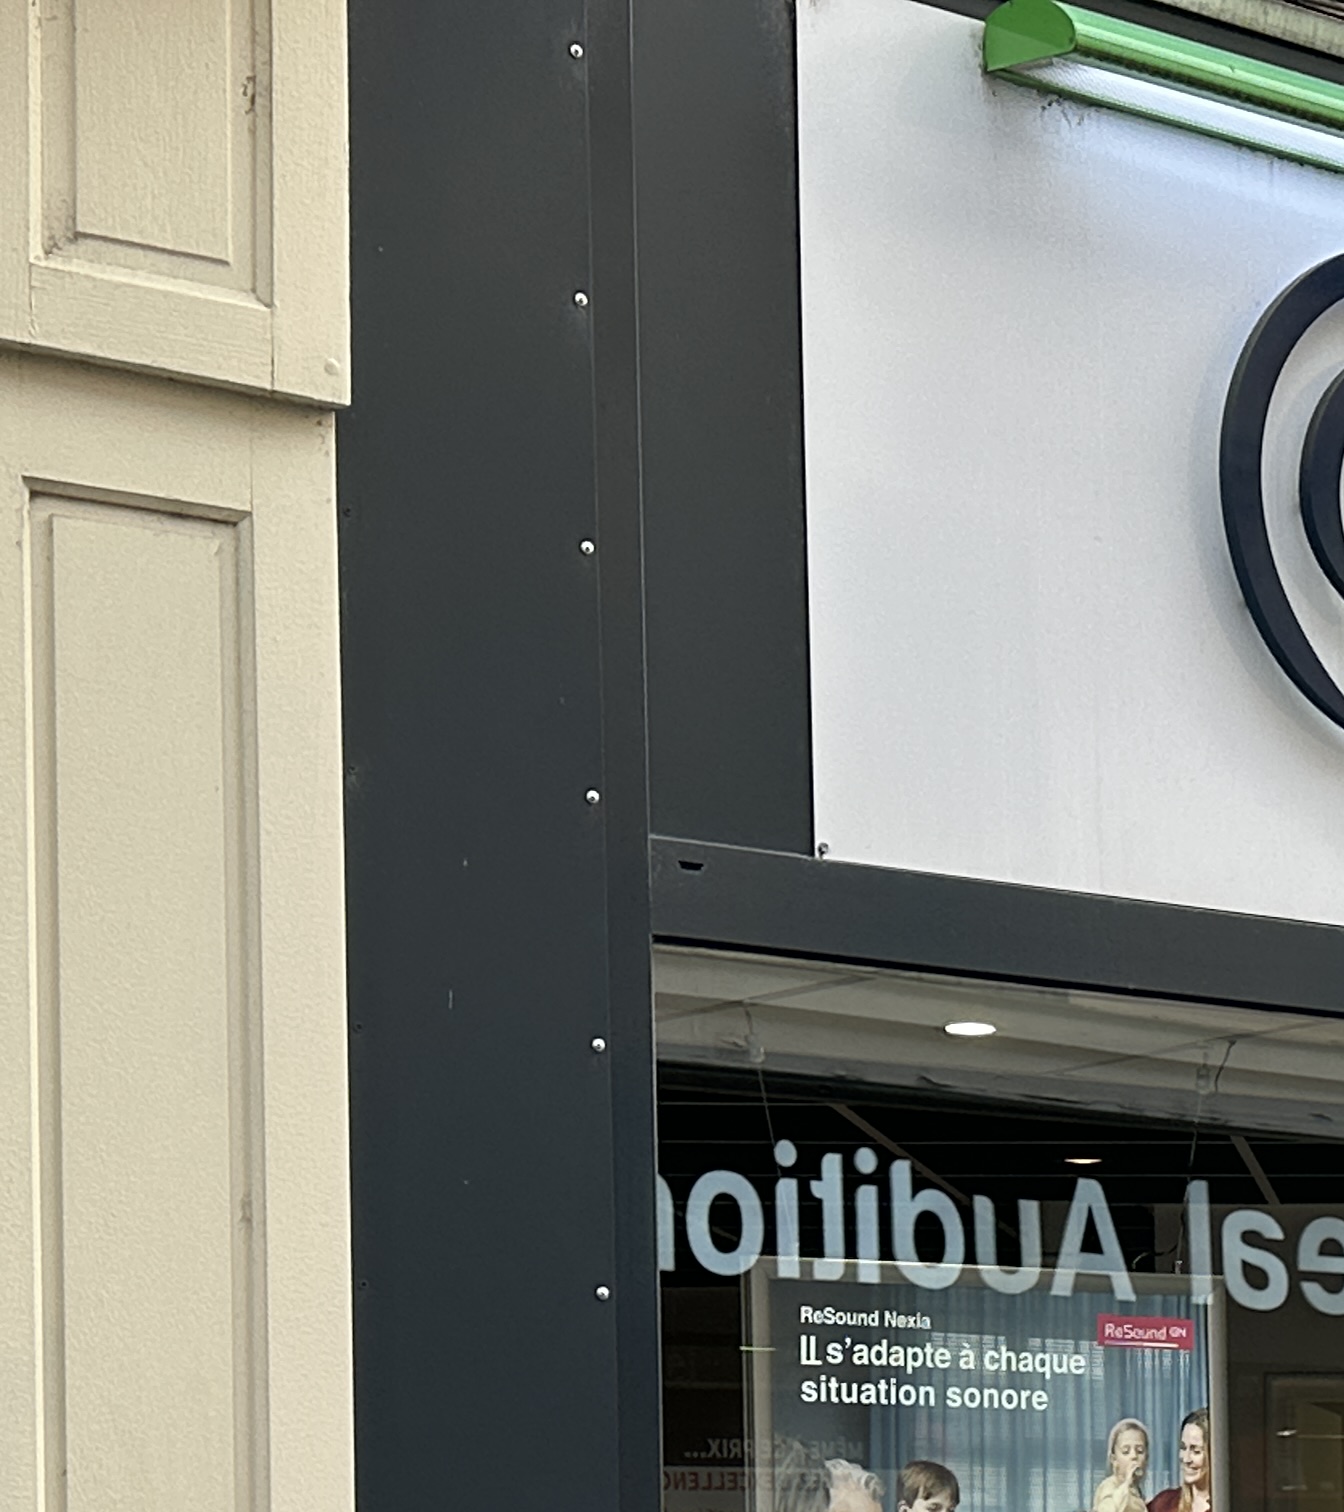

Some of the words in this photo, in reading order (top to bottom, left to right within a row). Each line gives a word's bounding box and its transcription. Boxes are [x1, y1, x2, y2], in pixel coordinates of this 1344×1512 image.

[800, 1305, 879, 1327] ReSound
[884, 1310, 932, 1329] Nexia
[1105, 1322, 1167, 1341] ReSound
[959, 1342, 976, 1369] à
[984, 1345, 1086, 1380] chaque
[800, 1374, 936, 1407] situation
[945, 1384, 1048, 1411] sonore
